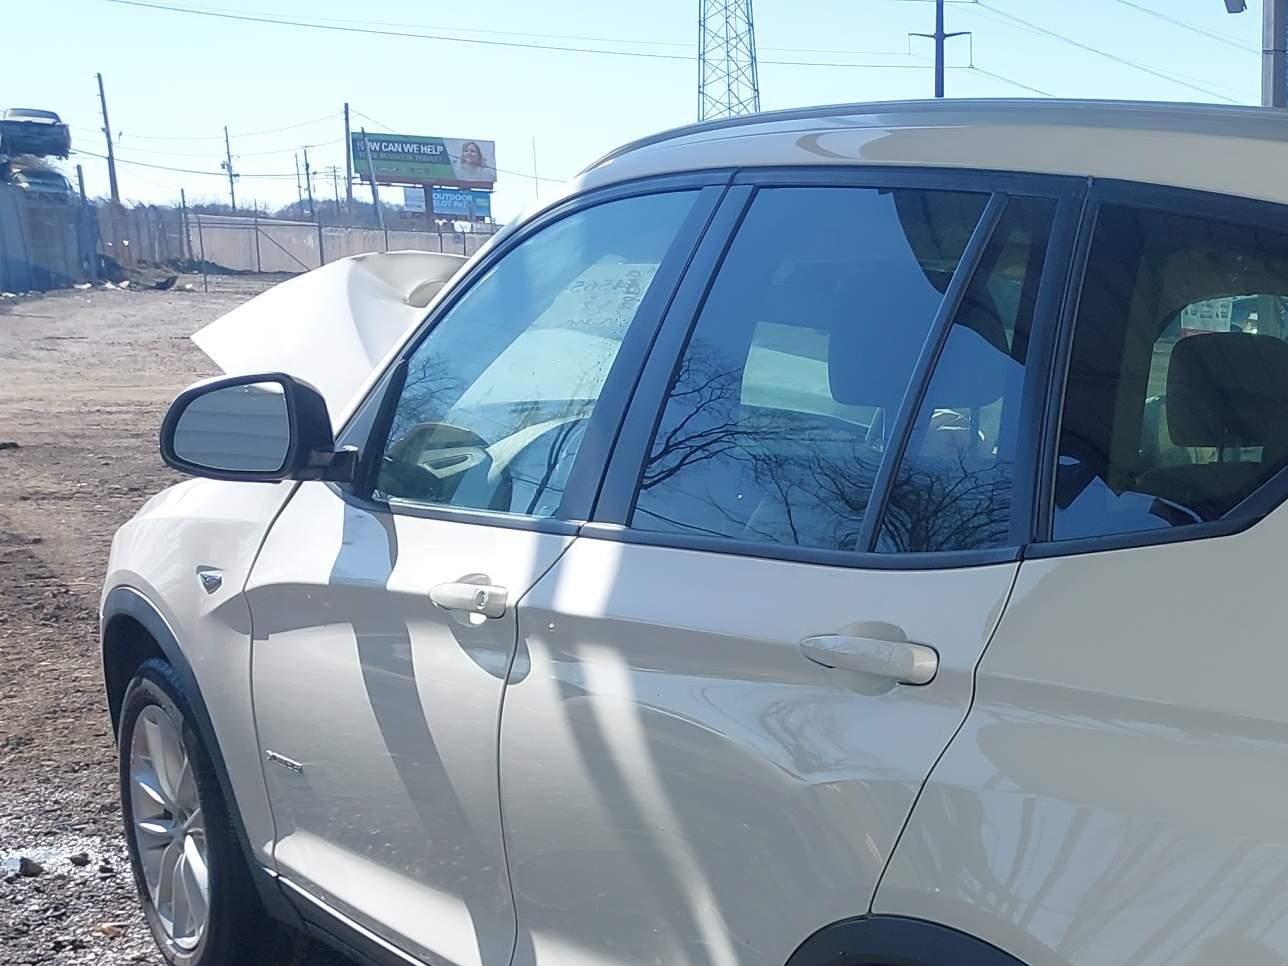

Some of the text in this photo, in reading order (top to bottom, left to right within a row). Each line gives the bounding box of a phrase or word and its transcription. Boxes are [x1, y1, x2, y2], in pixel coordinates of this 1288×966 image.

[381, 142, 402, 153] CAN
[402, 143, 420, 154] WE
[420, 145, 444, 155] HELP
[432, 192, 473, 201] OUTDOOR
